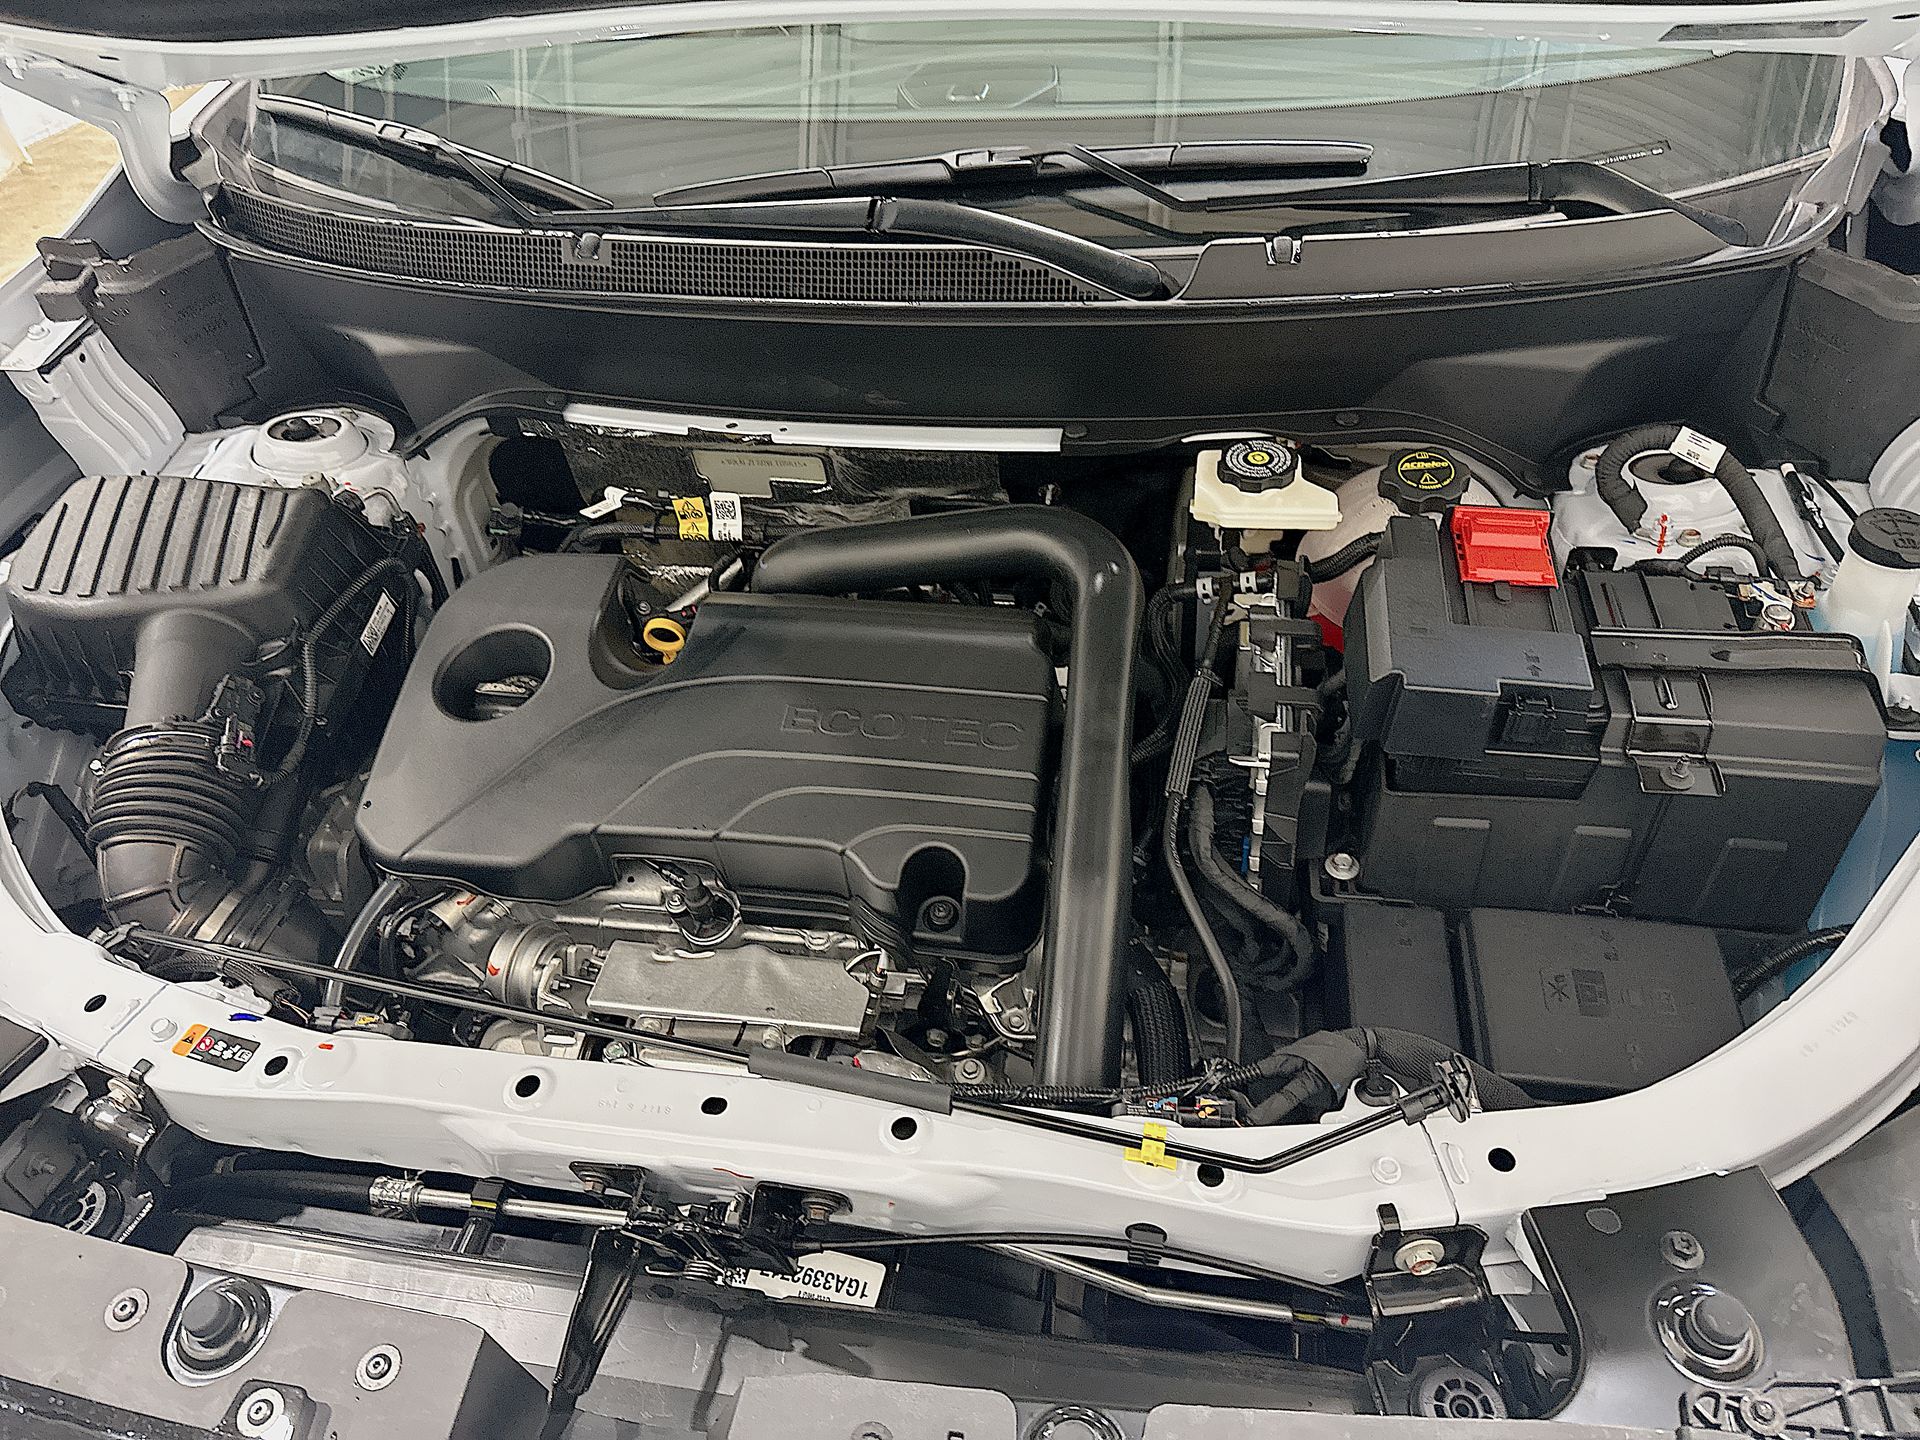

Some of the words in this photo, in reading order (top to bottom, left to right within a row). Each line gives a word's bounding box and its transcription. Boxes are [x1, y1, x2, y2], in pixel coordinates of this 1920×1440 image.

[1401, 461, 1449, 470] ACDelco
[780, 703, 1024, 751] ECOTEC
[760, 1265, 869, 1299] 1GA3392
